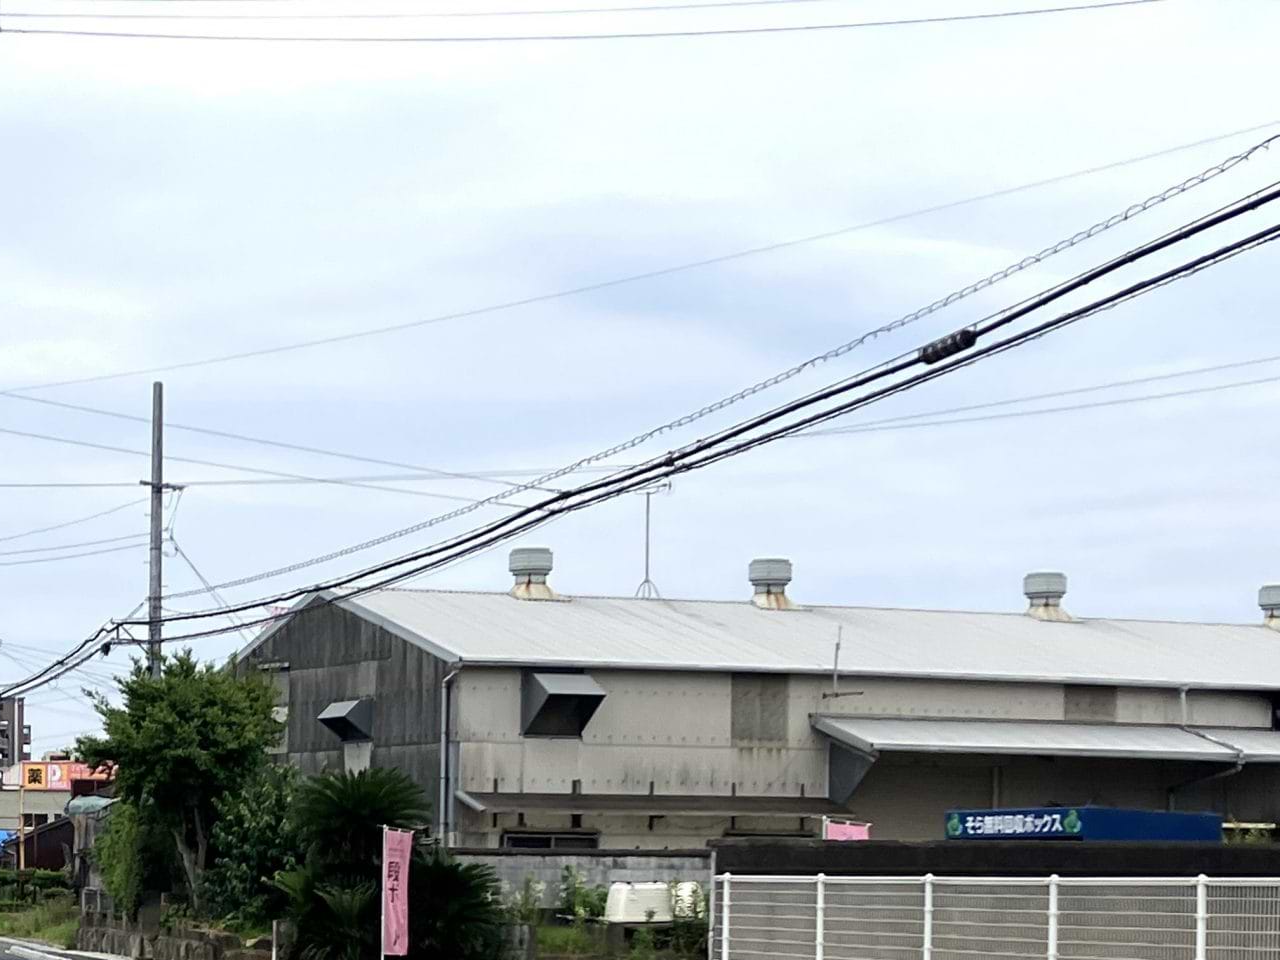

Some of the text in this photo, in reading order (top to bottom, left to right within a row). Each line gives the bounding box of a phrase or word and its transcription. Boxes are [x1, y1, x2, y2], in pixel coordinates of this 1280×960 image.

[27, 768, 42, 785] 薬
[965, 814, 1064, 835] そら無料回収ボックス
